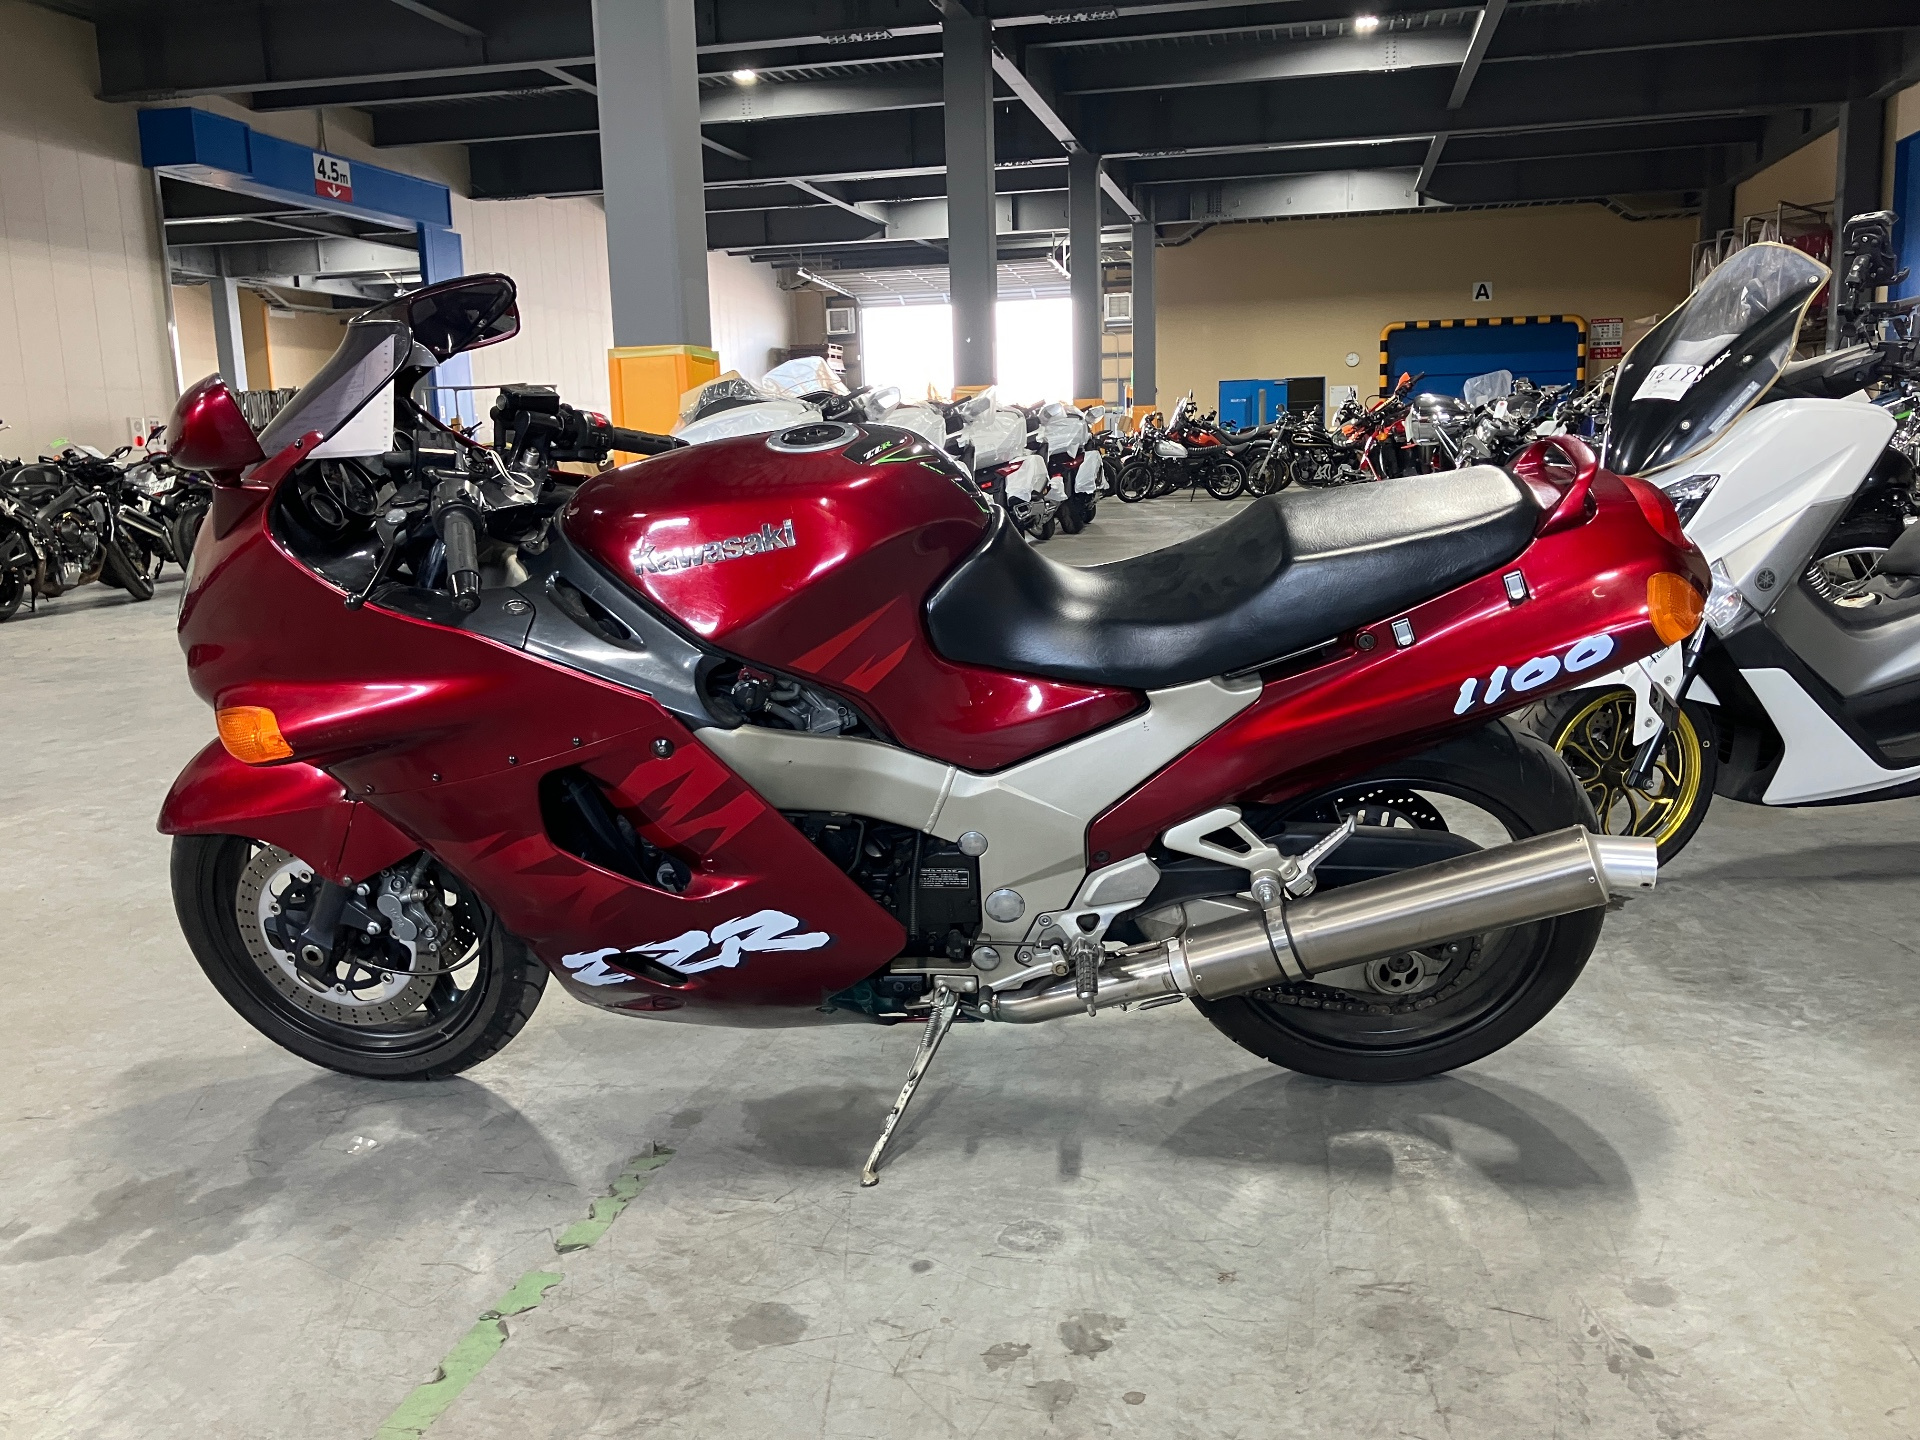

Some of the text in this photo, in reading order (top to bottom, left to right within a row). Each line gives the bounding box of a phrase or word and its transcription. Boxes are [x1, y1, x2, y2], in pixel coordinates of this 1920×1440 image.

[317, 158, 349, 184] 4.5m
[1475, 283, 1490, 300] A
[863, 440, 893, 460] ZZR
[633, 519, 797, 576] Kawasaki
[1453, 633, 1615, 715] 1100
[561, 909, 830, 986] ZZR
